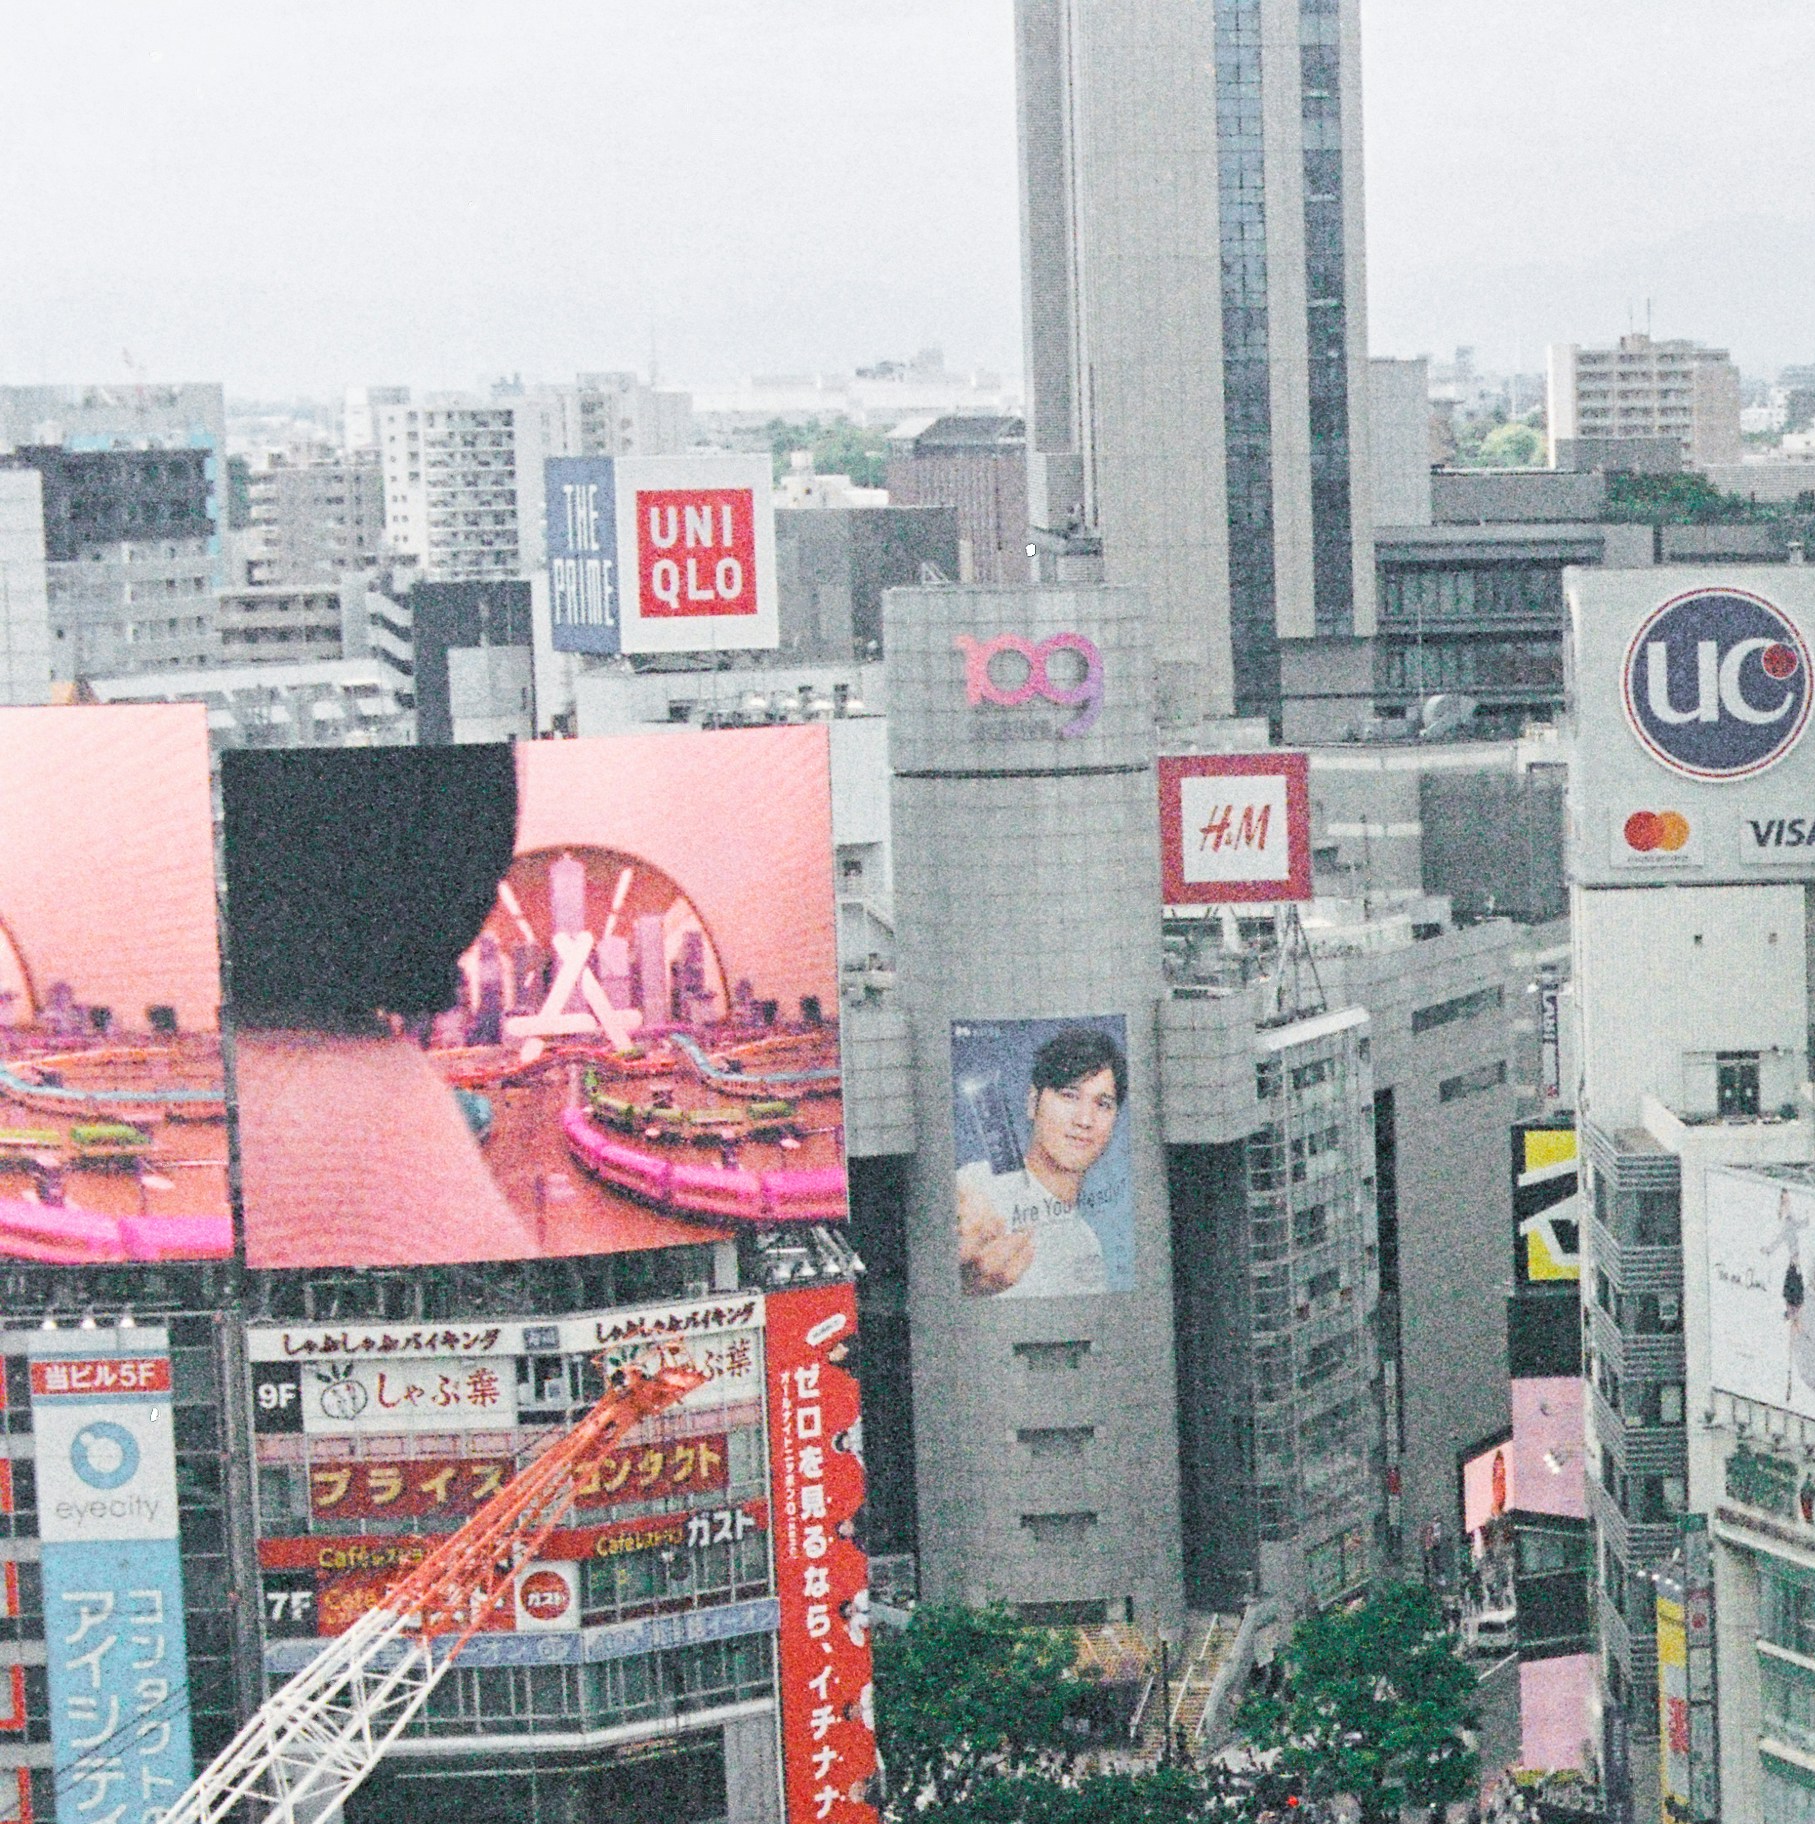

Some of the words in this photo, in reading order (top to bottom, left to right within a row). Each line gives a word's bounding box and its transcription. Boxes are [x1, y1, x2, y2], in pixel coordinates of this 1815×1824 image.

[563, 483, 600, 550] THE
[648, 505, 734, 548] UNI
[554, 559, 616, 626] PRIME
[650, 556, 743, 609] QLO
[953, 631, 1104, 738] 109
[1645, 635, 1795, 726] UC
[1199, 802, 1271, 854] H&M
[1012, 1200, 1040, 1227] Are
[1044, 1197, 1072, 1222] You
[44, 1362, 156, 1389] 当ビル5F
[258, 1382, 297, 1410] 9F
[377, 1367, 501, 1409] しゃぶ葉
[55, 1496, 161, 1528] eyecity
[687, 1507, 757, 1549] ガスト
[266, 1591, 313, 1621] 7F
